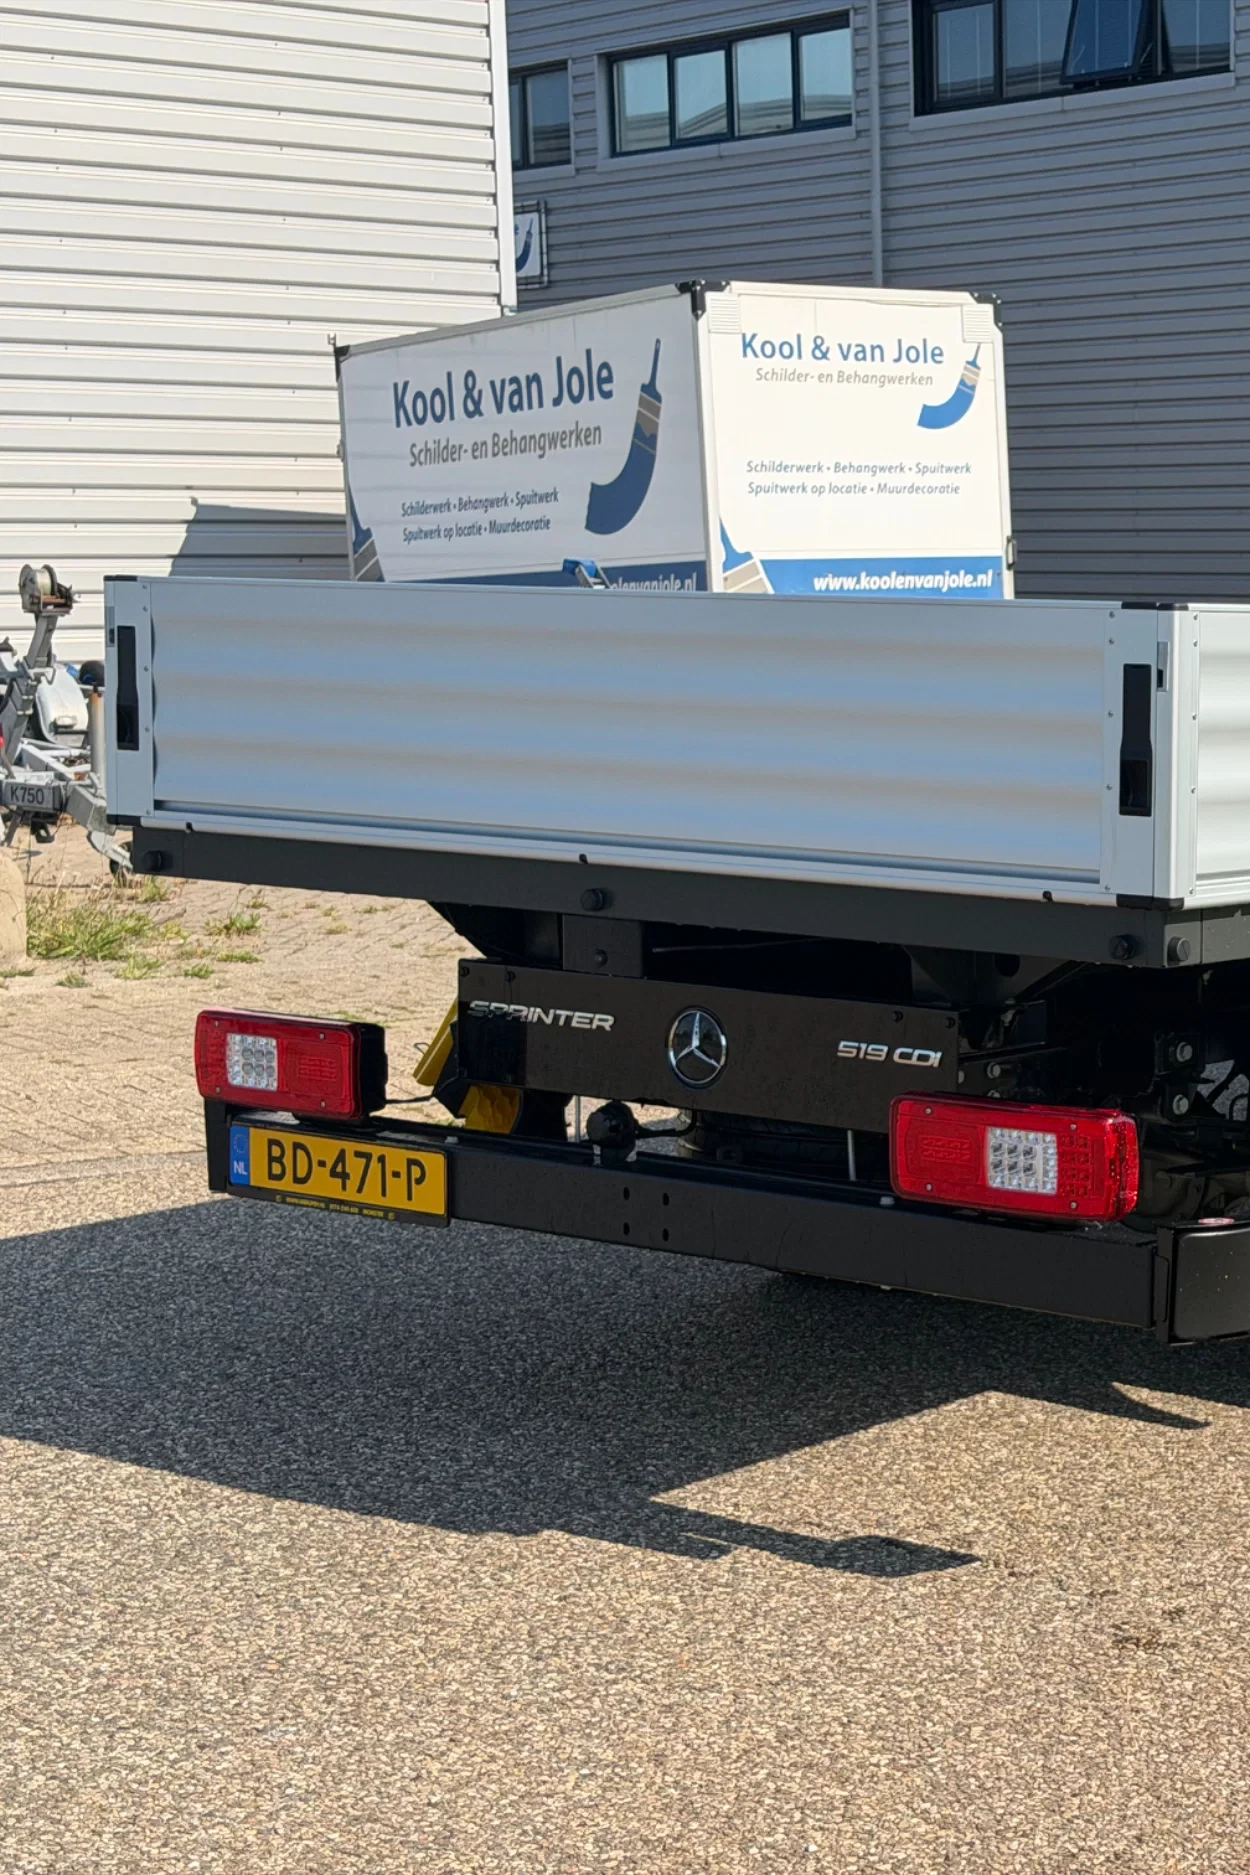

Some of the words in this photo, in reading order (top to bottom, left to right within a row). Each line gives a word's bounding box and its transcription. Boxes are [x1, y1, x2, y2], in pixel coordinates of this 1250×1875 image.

[741, 333, 803, 360] Kool
[811, 335, 831, 361] &
[837, 342, 885, 363] van
[893, 338, 945, 364] Jole
[393, 371, 455, 428] Kool
[462, 369, 484, 419] &
[489, 370, 544, 415] van
[552, 348, 614, 407] Jole
[756, 367, 815, 383] Schilder-
[818, 372, 833, 383] en
[837, 370, 934, 388] Behangwerken
[409, 439, 468, 468] Schilder-
[472, 443, 488, 460] en
[492, 420, 602, 460] Behangwerken
[746, 460, 824, 474] Schilderwerk
[833, 461, 906, 477] Behangwerk
[915, 462, 972, 476] Spuitwerk
[401, 498, 453, 517] Schilderwerk
[458, 491, 509, 514] Behangwerk
[515, 486, 559, 510] Spuitwerk
[748, 481, 808, 497] Spuitwerk
[811, 485, 826, 498] op
[828, 482, 868, 495] locatie
[877, 482, 961, 495] Muurdecoratie
[402, 523, 442, 545] Spuitwerk
[443, 529, 454, 542] op
[455, 521, 482, 538] locatie
[488, 515, 551, 534] Muurdecoratie
[813, 569, 993, 594] www.koolenvanjole.nl
[10, 785, 45, 805] K750
[466, 1000, 615, 1032] SPRINTER
[837, 1040, 888, 1062] 519
[893, 1046, 942, 1067] CDI
[233, 1160, 248, 1176] NL
[266, 1138, 427, 1202] BD-471-P
